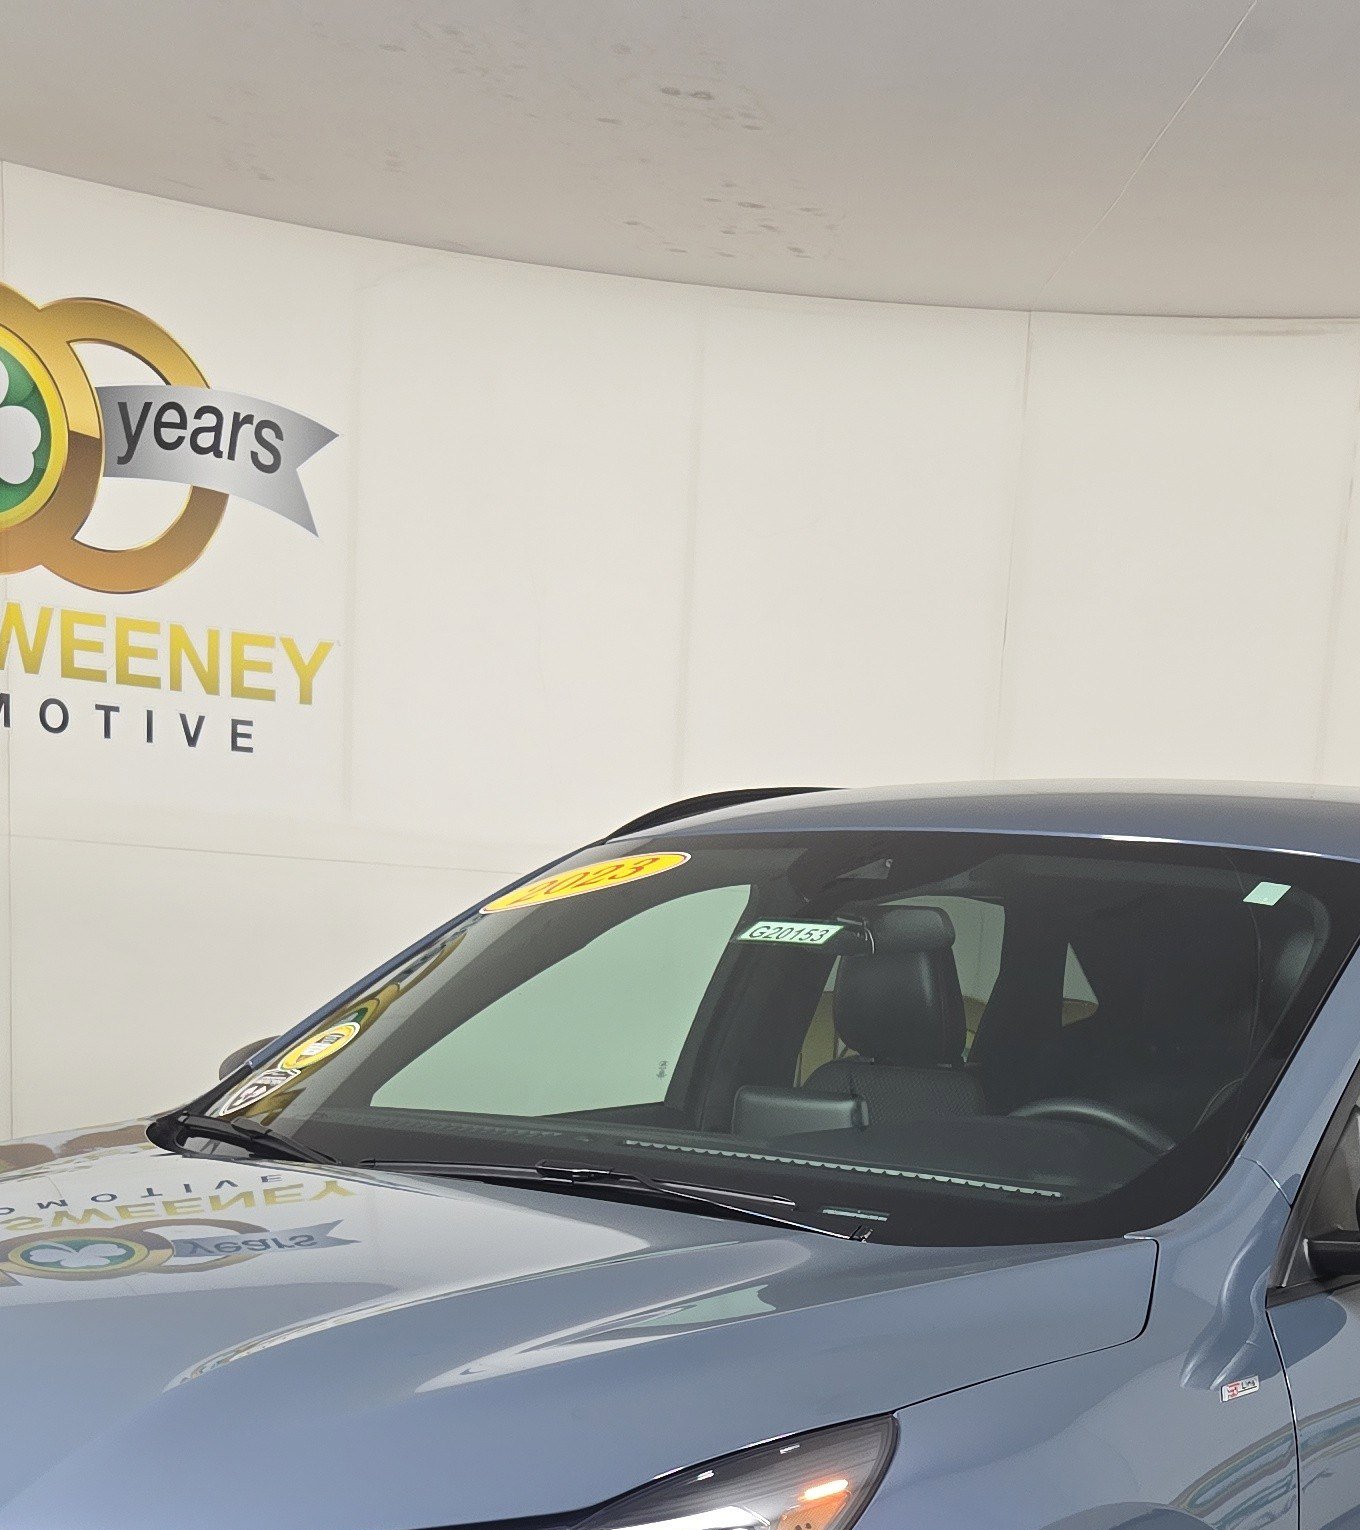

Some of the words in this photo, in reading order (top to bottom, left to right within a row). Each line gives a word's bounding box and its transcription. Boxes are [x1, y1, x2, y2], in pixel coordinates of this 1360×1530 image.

[116, 400, 285, 473] years
[506, 857, 661, 906] 2023
[748, 925, 830, 942] G20153
